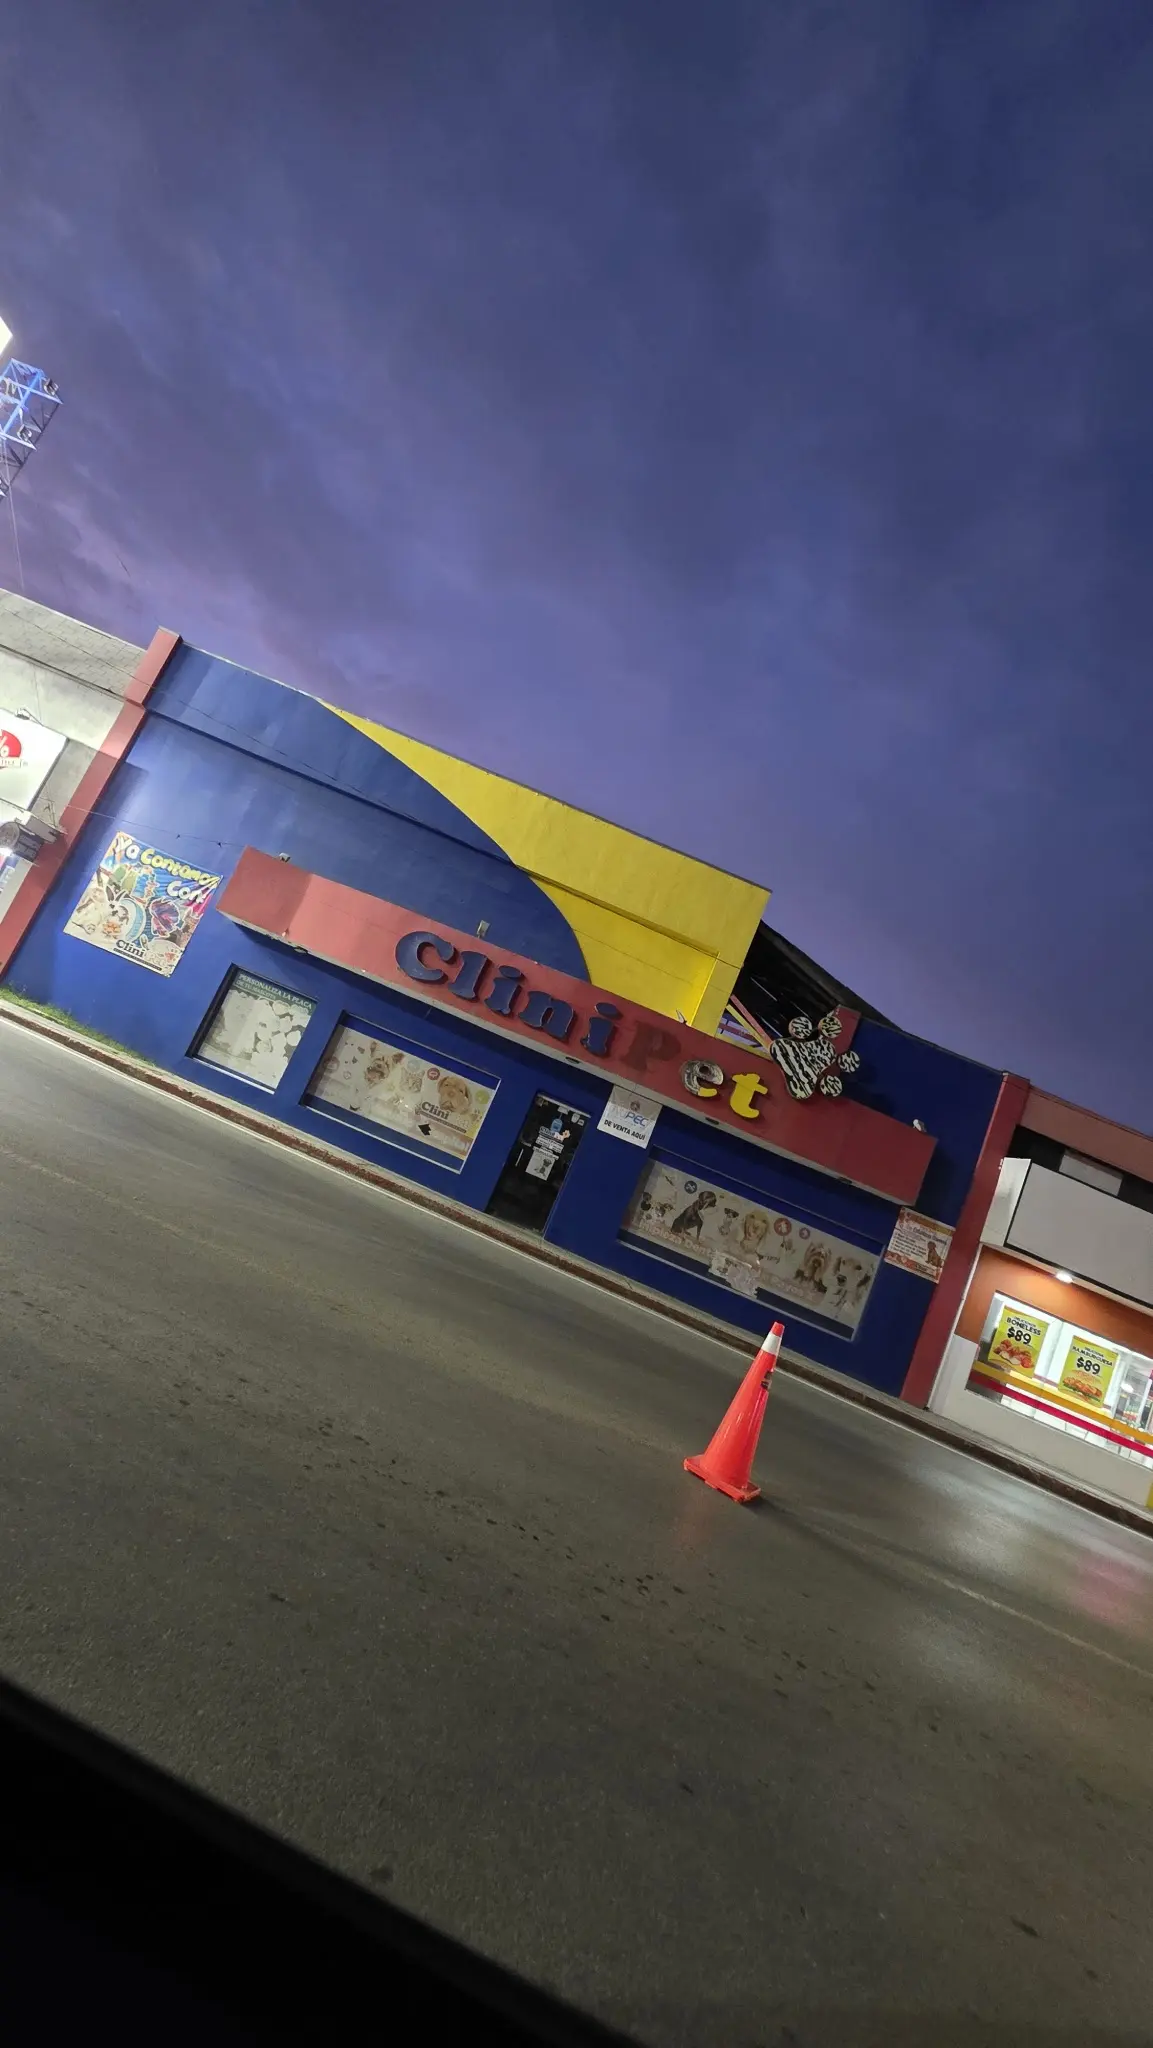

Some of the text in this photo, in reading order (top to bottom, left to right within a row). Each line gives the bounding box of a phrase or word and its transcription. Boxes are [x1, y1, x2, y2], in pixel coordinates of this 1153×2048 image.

[116, 837, 140, 859] Ya
[238, 973, 312, 1010] PERSONALIZA LA PLACA
[613, 1122, 630, 1135] VENTA
[1006, 1317, 1041, 1336] BONELESS
[1007, 1326, 1032, 1345] $89
[1076, 1356, 1101, 1375] $89
